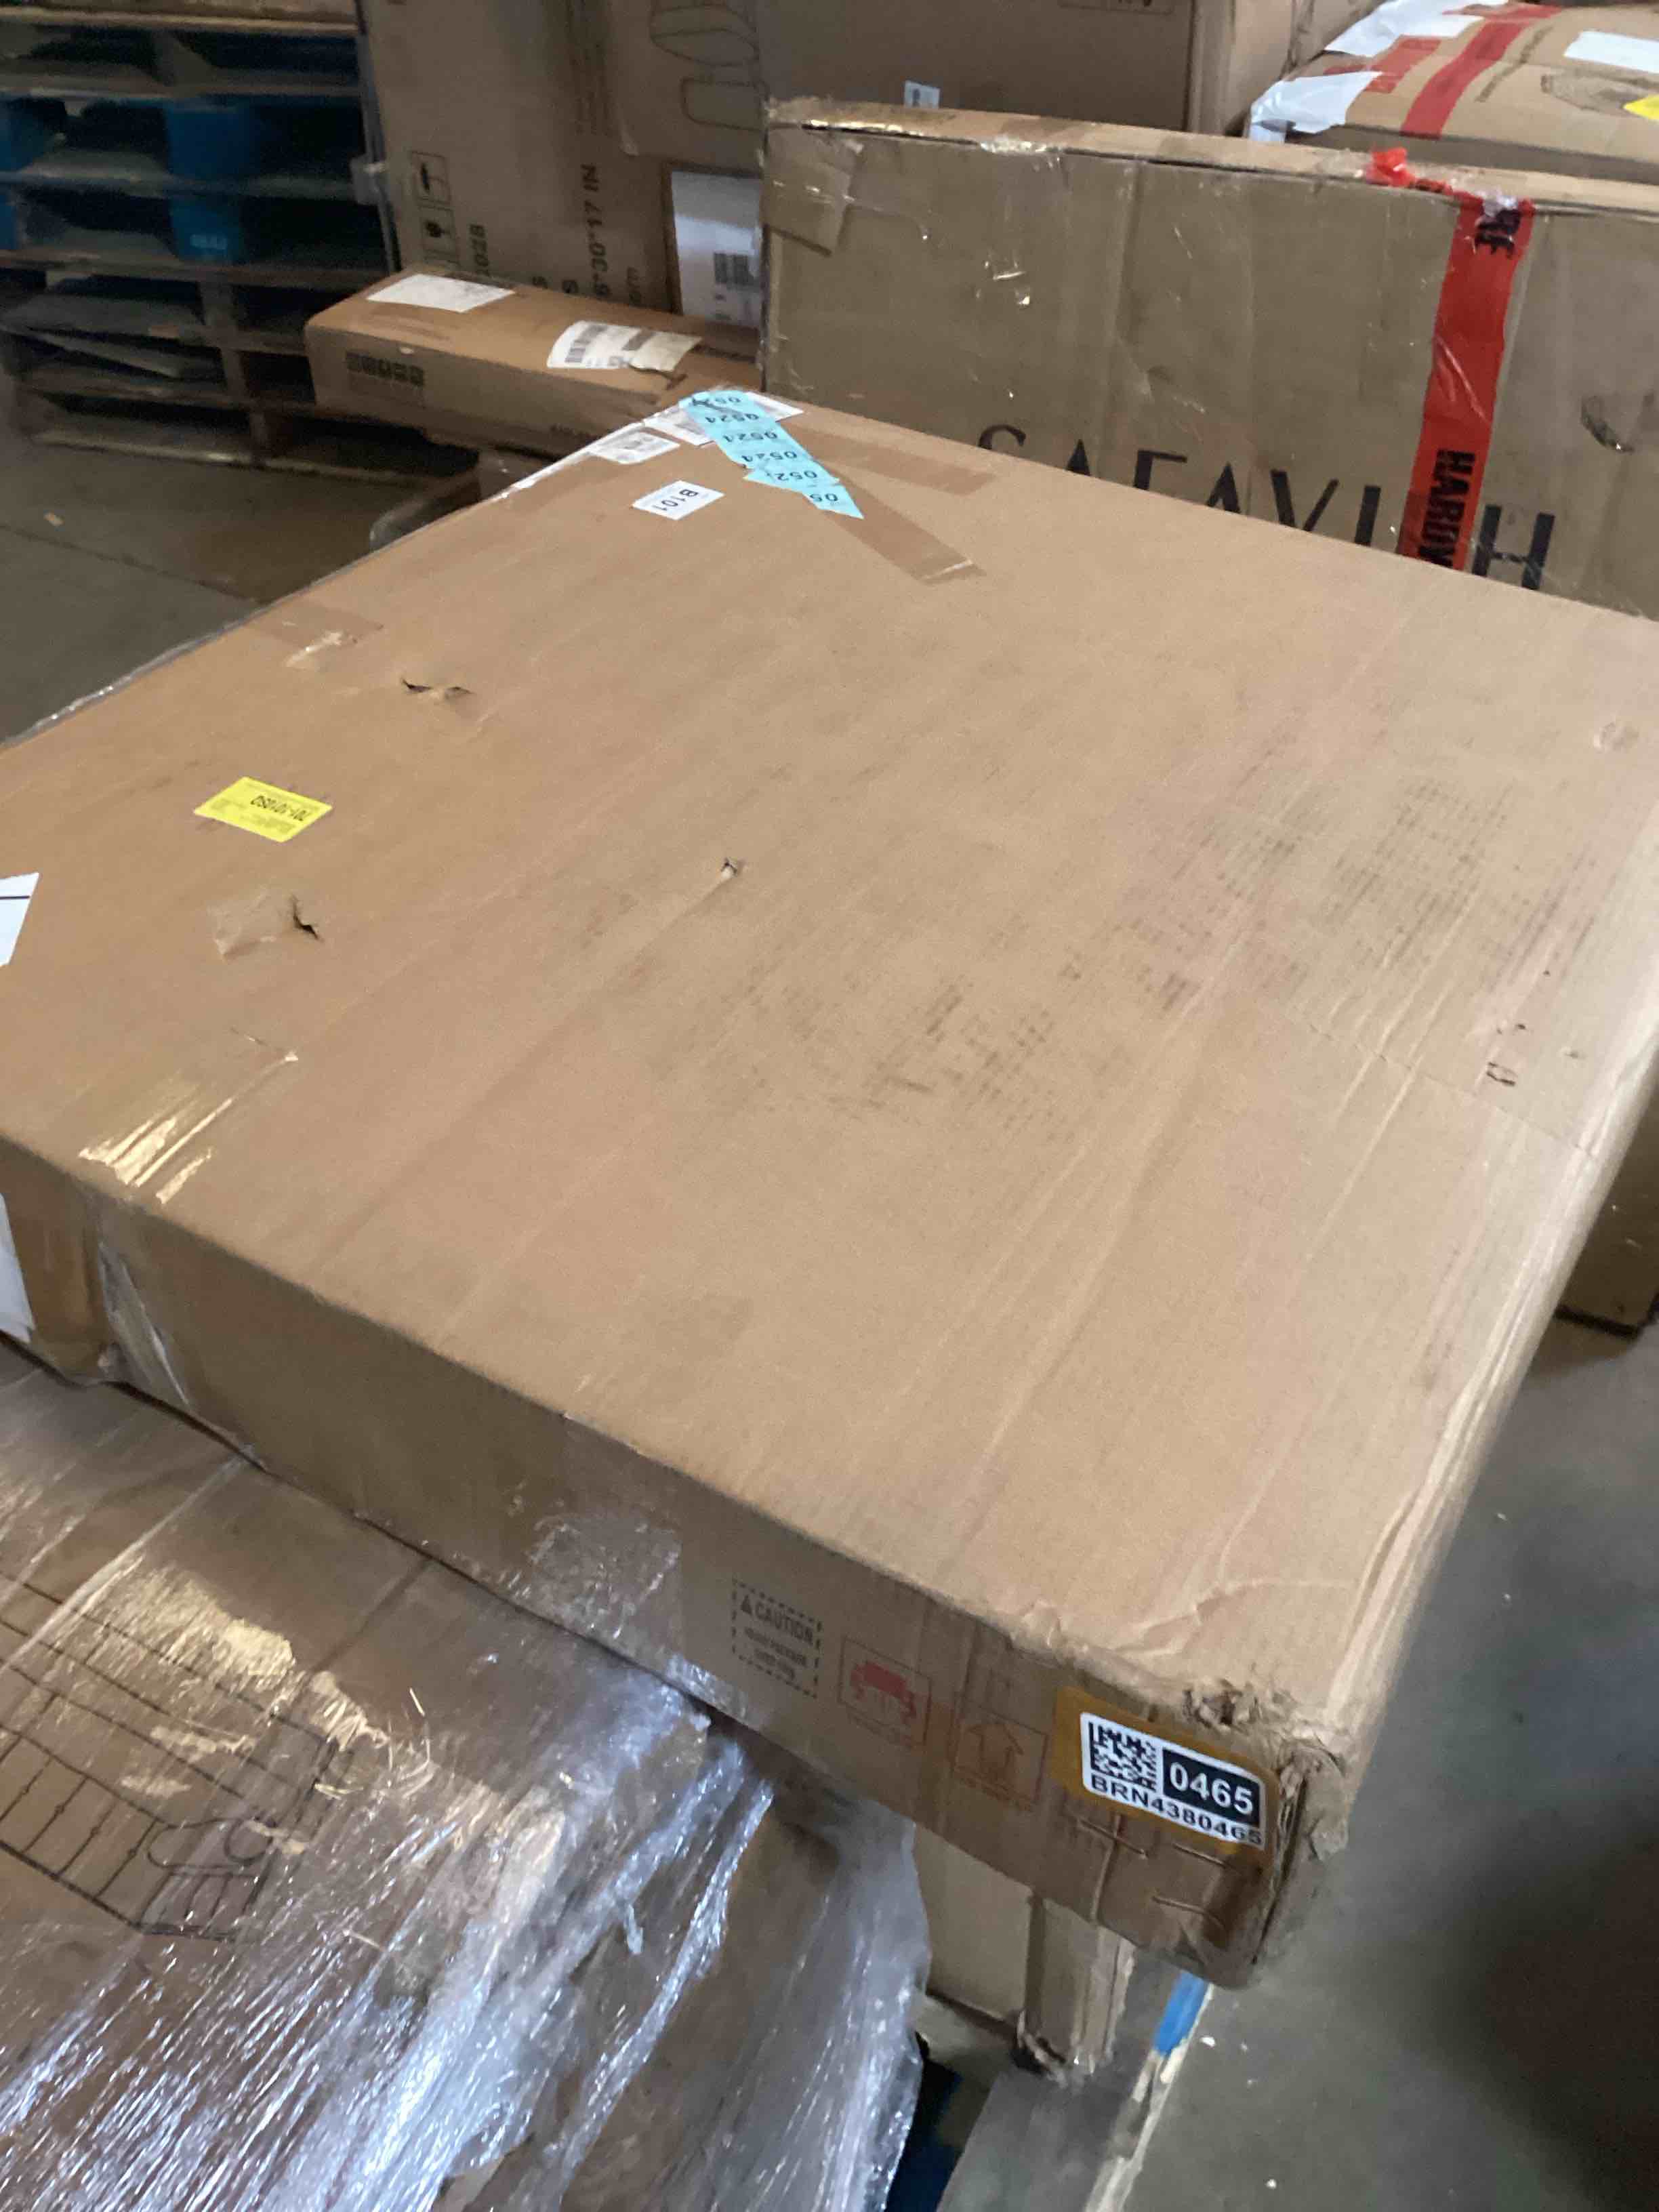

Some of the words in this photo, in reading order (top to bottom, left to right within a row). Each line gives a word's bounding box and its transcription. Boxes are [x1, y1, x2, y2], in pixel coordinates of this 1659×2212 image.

[653, 488, 699, 512] B101
[754, 1599, 814, 1646] CAUTION
[1091, 1773, 1263, 1846] BRN4380465
[1168, 1761, 1254, 1817] 0465
